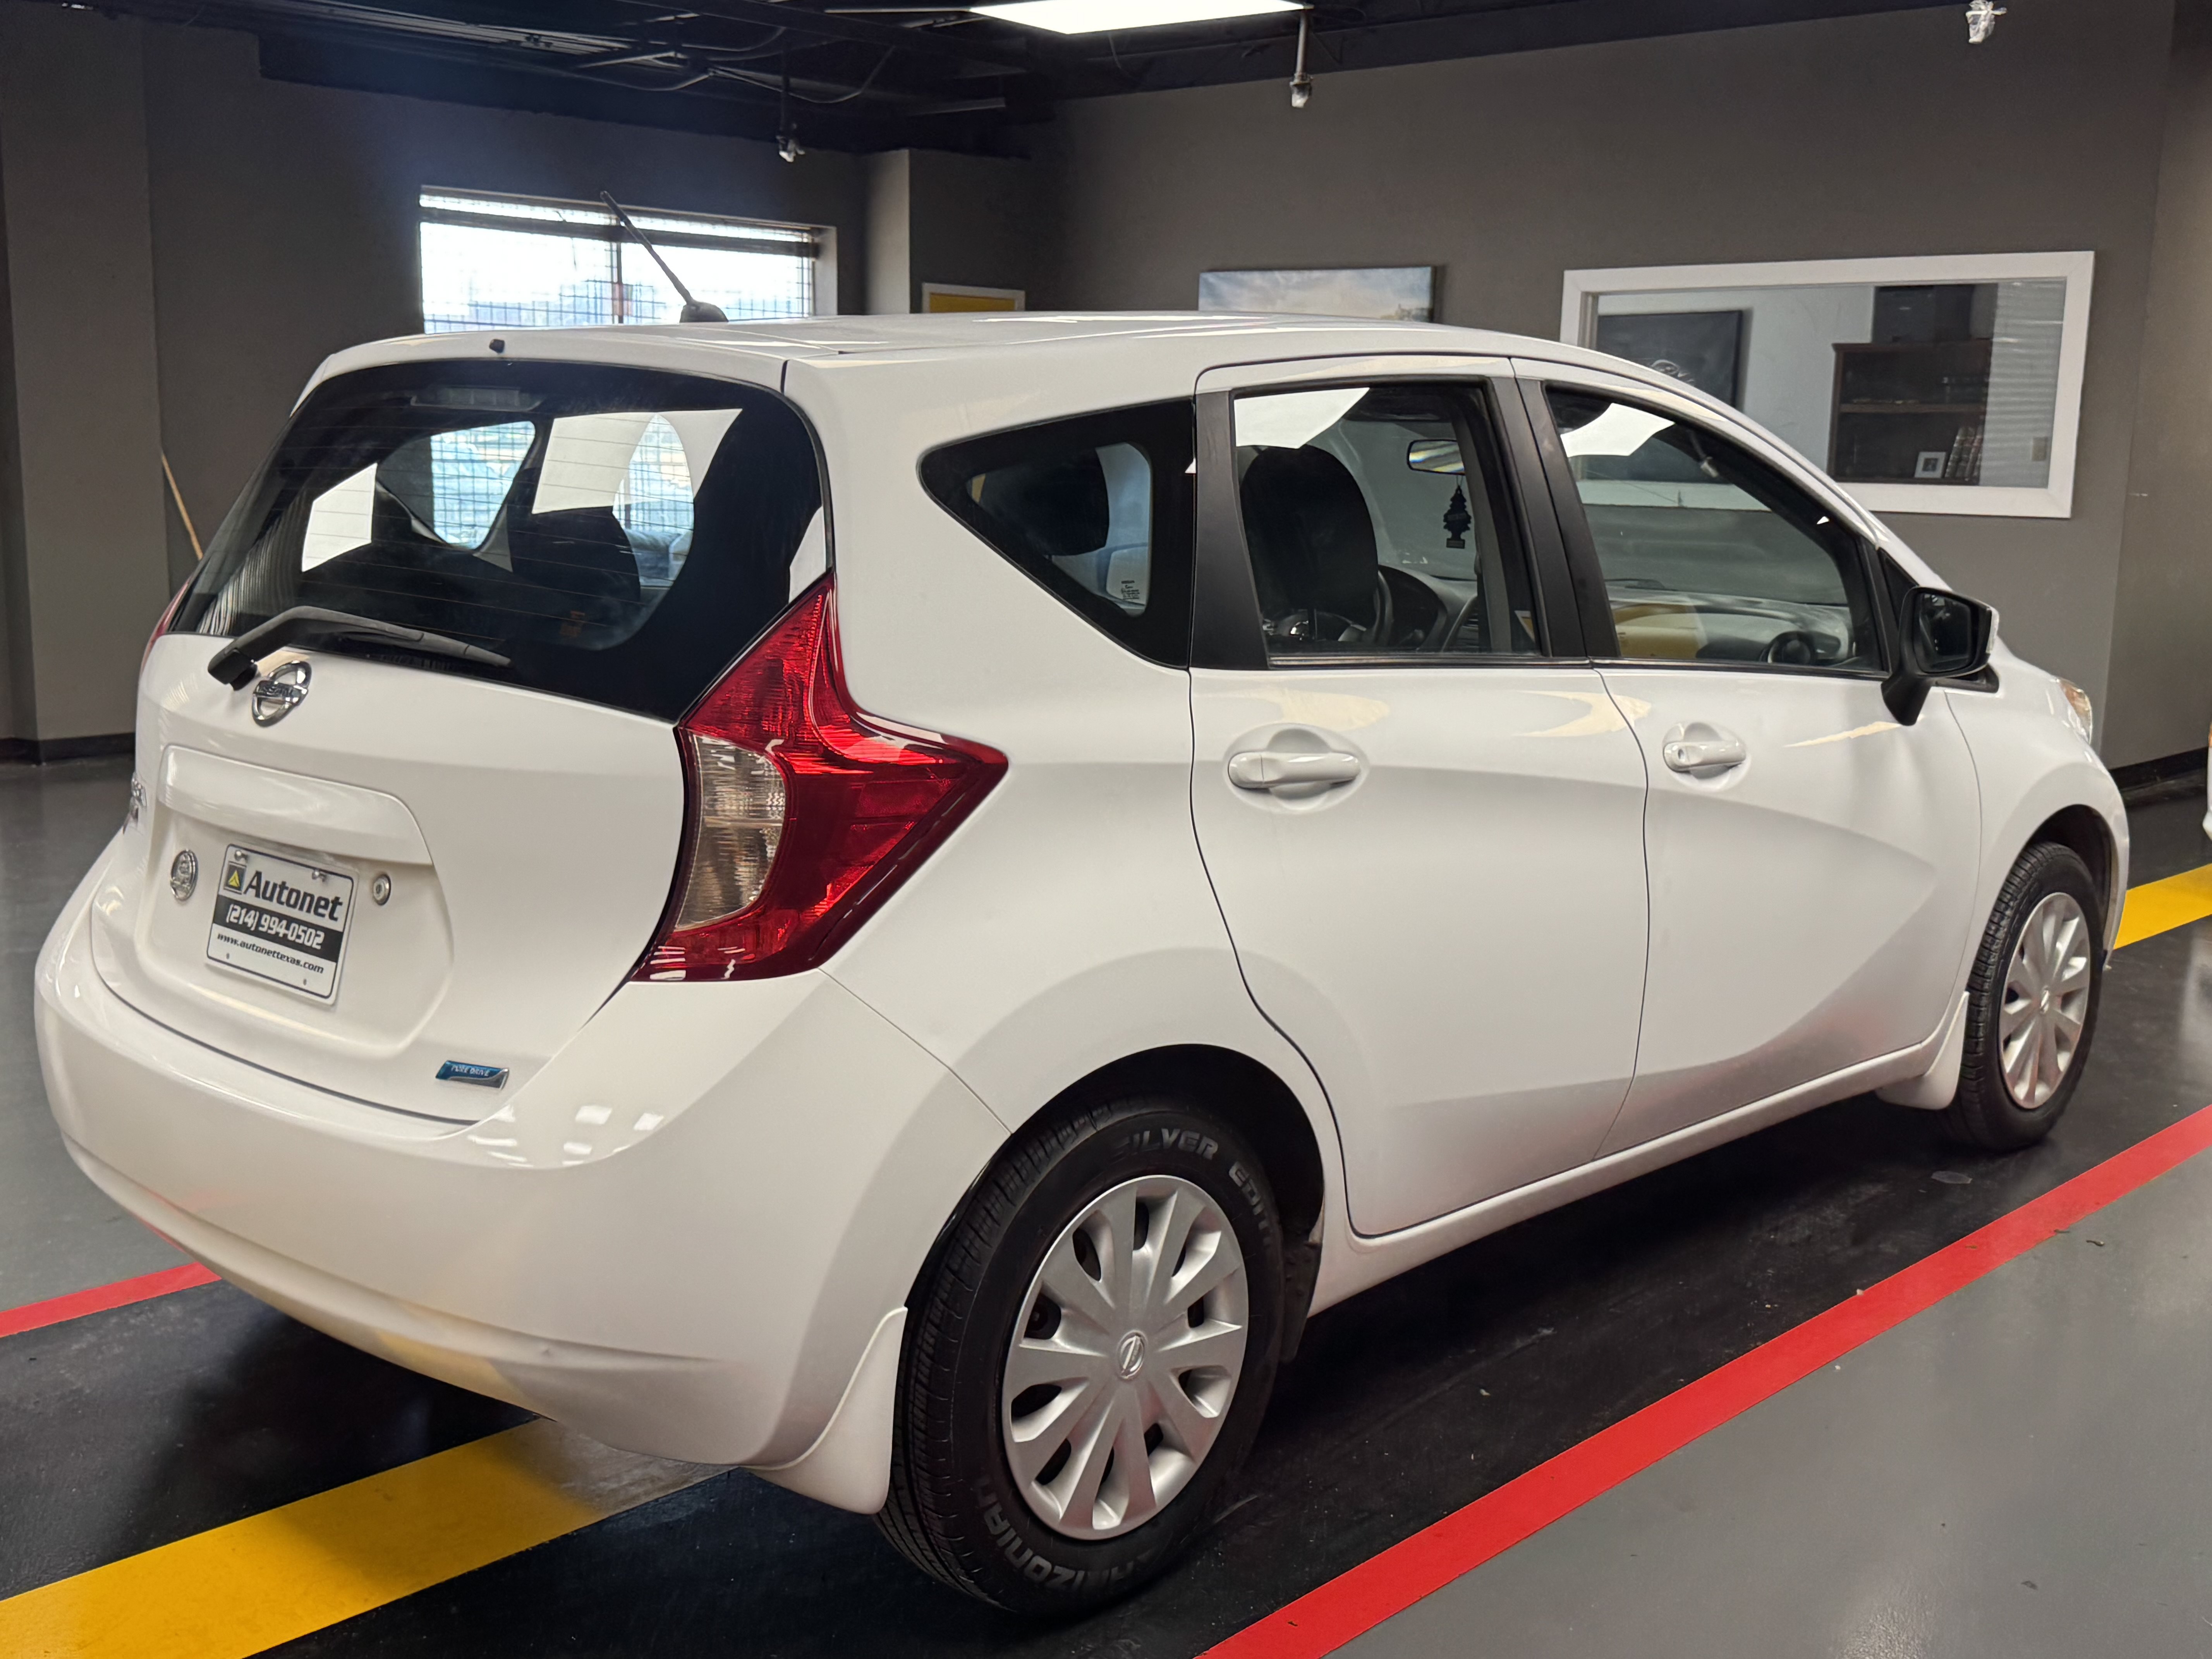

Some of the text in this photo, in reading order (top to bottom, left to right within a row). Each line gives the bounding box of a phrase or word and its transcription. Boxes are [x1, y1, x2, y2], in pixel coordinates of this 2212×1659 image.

[243, 870, 343, 922] Autonet
[226, 904, 325, 950] (214) 994-0502
[217, 933, 325, 974] www.autonettexas.com
[469, 1067, 490, 1076] DRIVE
